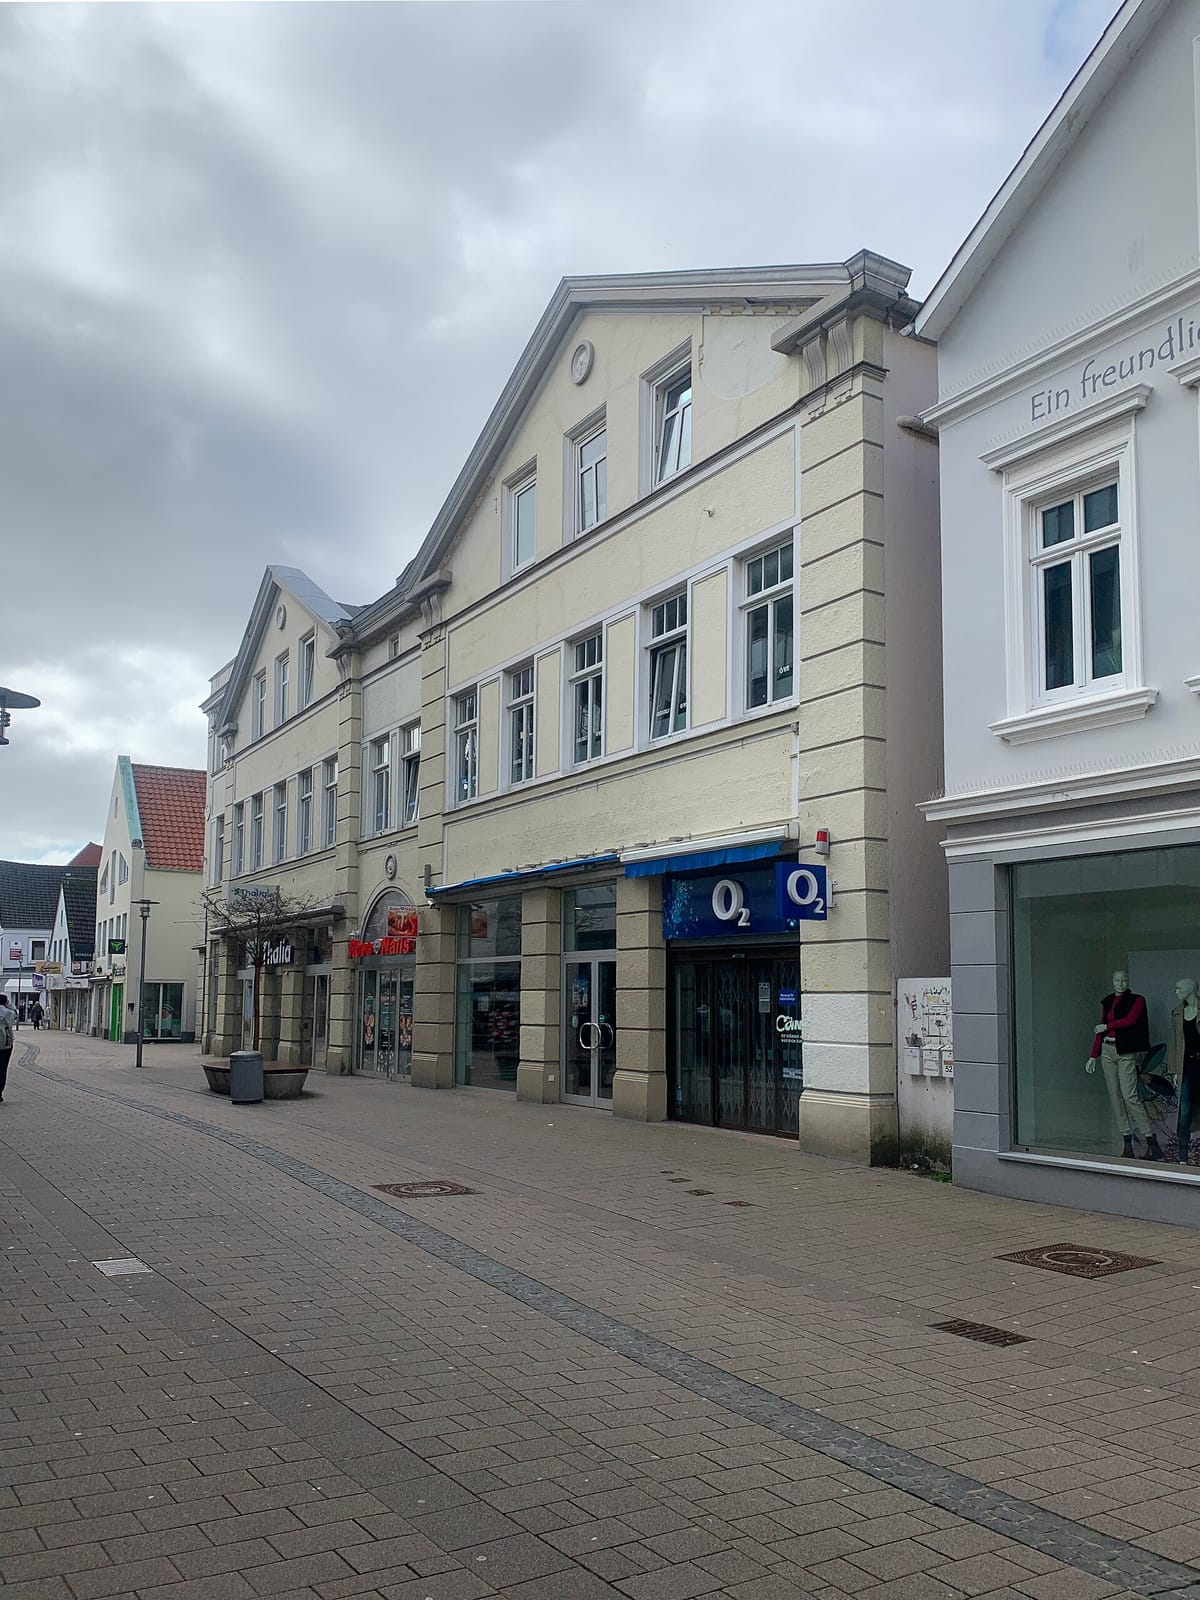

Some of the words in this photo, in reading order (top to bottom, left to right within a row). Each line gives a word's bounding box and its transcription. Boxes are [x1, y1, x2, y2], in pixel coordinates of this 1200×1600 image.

[1031, 389, 1070, 421] Ein
[1080, 317, 1200, 398] freundli
[712, 879, 751, 926] O2
[787, 869, 825, 913] O2
[348, 938, 373, 959] Rose
[381, 936, 411, 955] Nails
